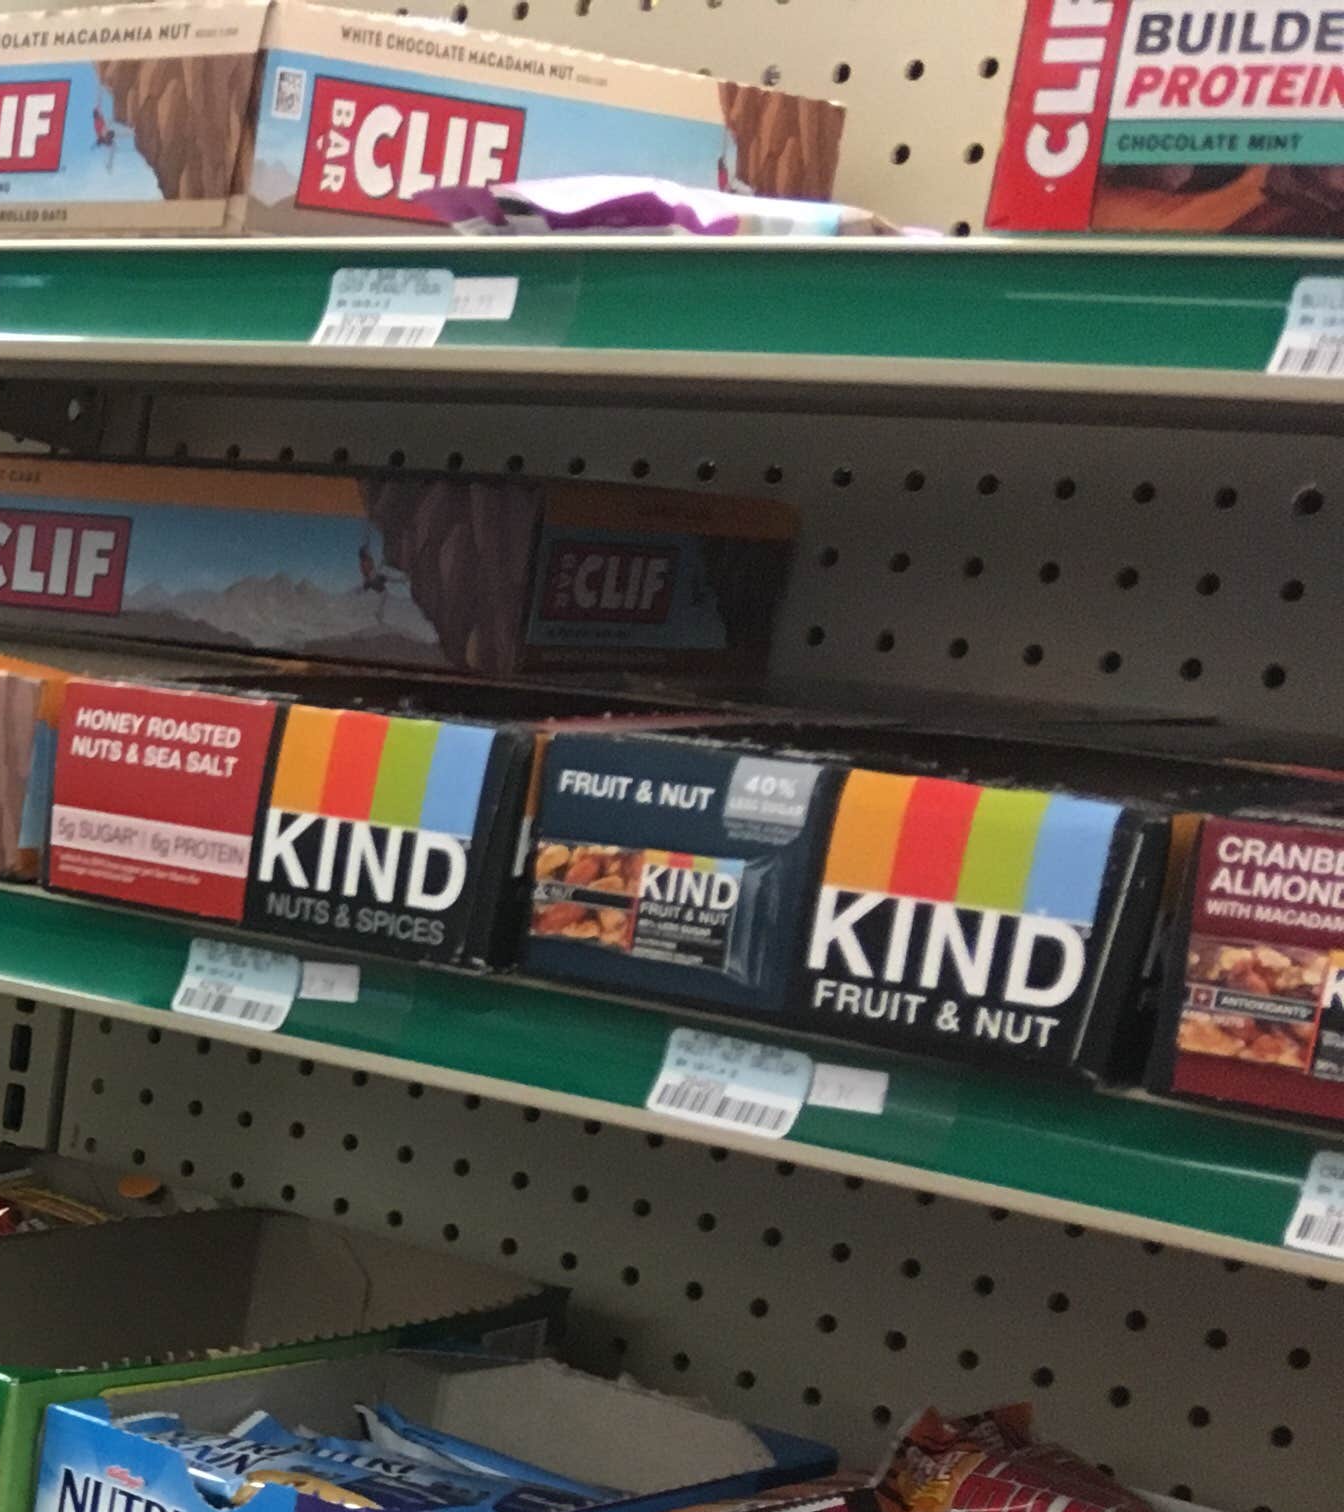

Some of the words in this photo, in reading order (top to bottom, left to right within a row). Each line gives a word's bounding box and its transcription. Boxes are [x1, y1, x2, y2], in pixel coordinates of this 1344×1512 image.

[53, 26, 153, 46] MACADAMIA
[157, 23, 191, 41] NUT
[341, 25, 383, 49] WHITE
[386, 33, 465, 62] CHOCOLATE
[468, 48, 546, 77] MACADAMIA
[549, 62, 574, 83] NUT
[319, 98, 357, 192] BAR
[353, 104, 510, 200] CLIF
[1118, 134, 1239, 152] CHOCOLATE
[1247, 132, 1304, 151] MINT
[76, 707, 144, 736] HONEY
[147, 716, 241, 750] ROASTED
[71, 735, 122, 763] NUTS
[125, 743, 140, 764] &
[143, 745, 182, 770] SEA
[185, 751, 239, 778] SALT
[558, 769, 634, 799] FRUIT
[635, 779, 653, 804] &
[659, 783, 716, 811] NUT
[744, 775, 798, 799] 40%
[175, 835, 246, 868] PROTEIN
[258, 807, 469, 912] KIND
[639, 863, 739, 910] KIND
[267, 892, 330, 925] NUTS
[334, 901, 351, 928] &
[355, 907, 447, 948] SPICES
[1206, 899, 1251, 919] WITH
[807, 886, 1086, 1009] KIND
[812, 978, 928, 1026] FRUIT
[937, 1002, 961, 1034] &
[974, 1007, 1059, 1049] NUT
